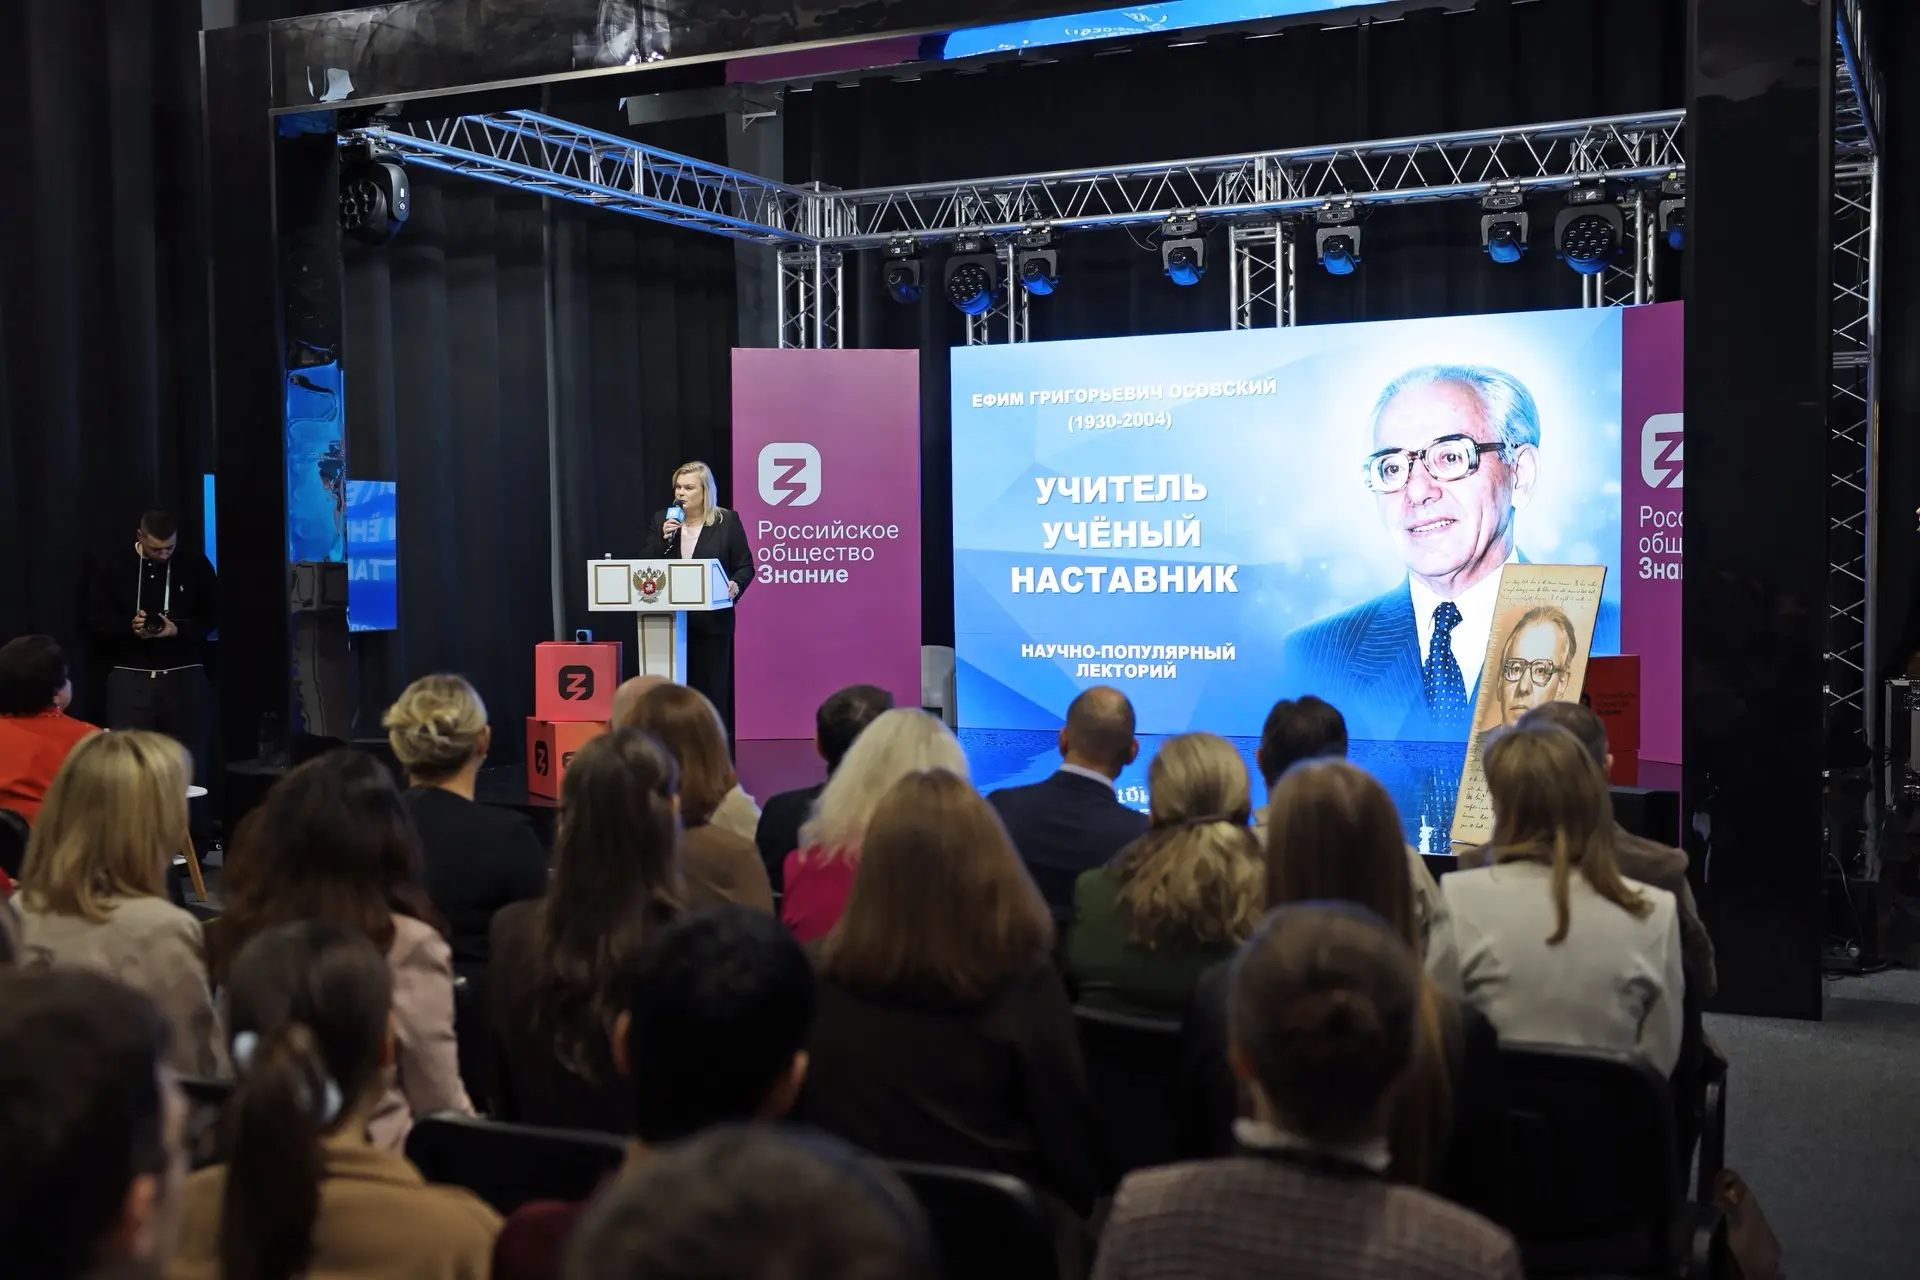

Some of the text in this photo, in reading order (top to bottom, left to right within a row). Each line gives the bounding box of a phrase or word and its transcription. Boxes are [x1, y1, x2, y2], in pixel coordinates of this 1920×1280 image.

[972, 376, 1278, 408] ЕФИМ ГРИГОРЬЕВИЧ ОСОВСКИЙ
[1068, 411, 1173, 434] (1930-2004)
[1035, 473, 1208, 505] УЧИТЕЛЬ
[757, 520, 899, 540] Российское
[1042, 513, 1202, 550] УЧЁНЫЙ
[757, 542, 875, 565] общество
[757, 564, 849, 584] Знание
[1010, 563, 1240, 595] НАСТАВНИК
[1639, 557, 1683, 580] Зна
[1021, 642, 1237, 662] НАУЧНО-ПОПУЛЯРНЫЙ
[1076, 661, 1177, 680] ЛЕКТОРИЙ
